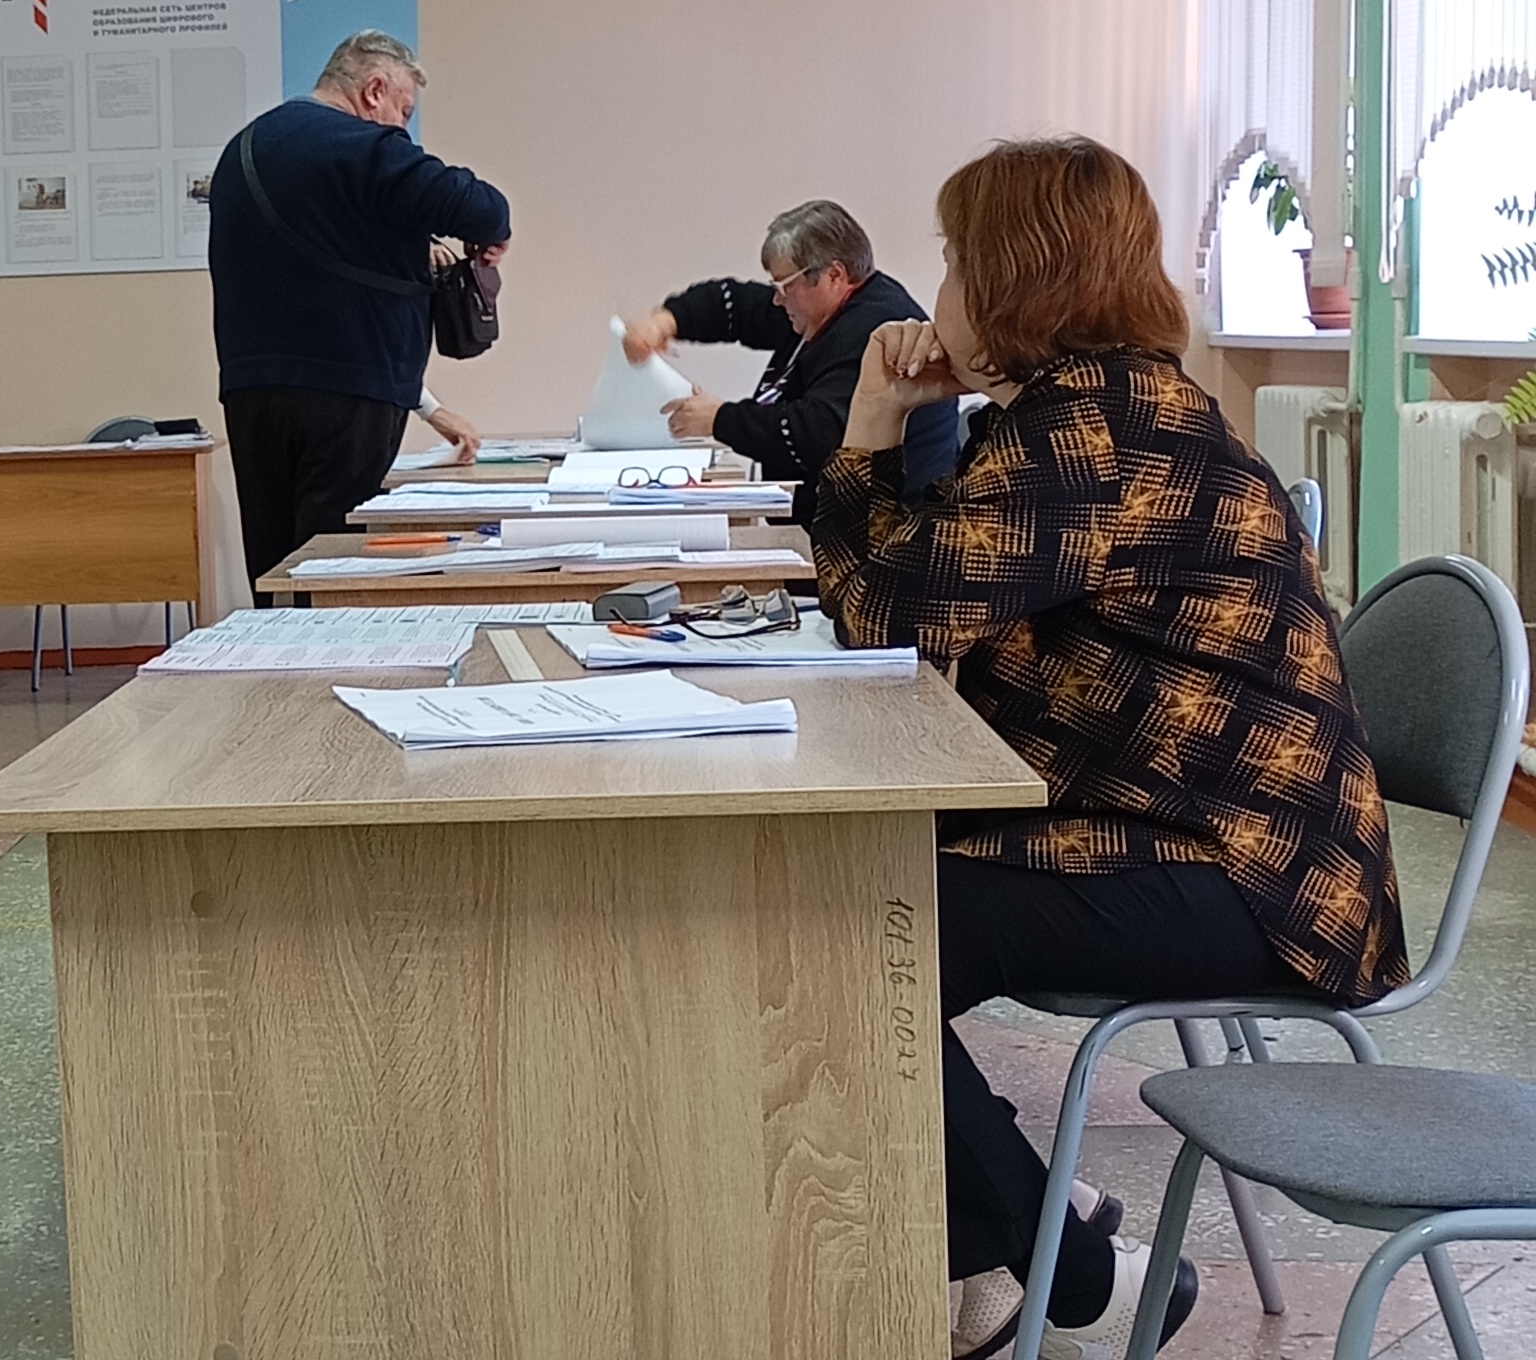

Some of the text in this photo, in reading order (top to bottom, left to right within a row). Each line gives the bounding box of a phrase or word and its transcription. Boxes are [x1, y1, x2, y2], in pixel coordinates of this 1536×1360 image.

[92, 2, 227, 16] ФЕДЕРАЛЬНАЯ СЕТЬ ЦЕНТРОВ
